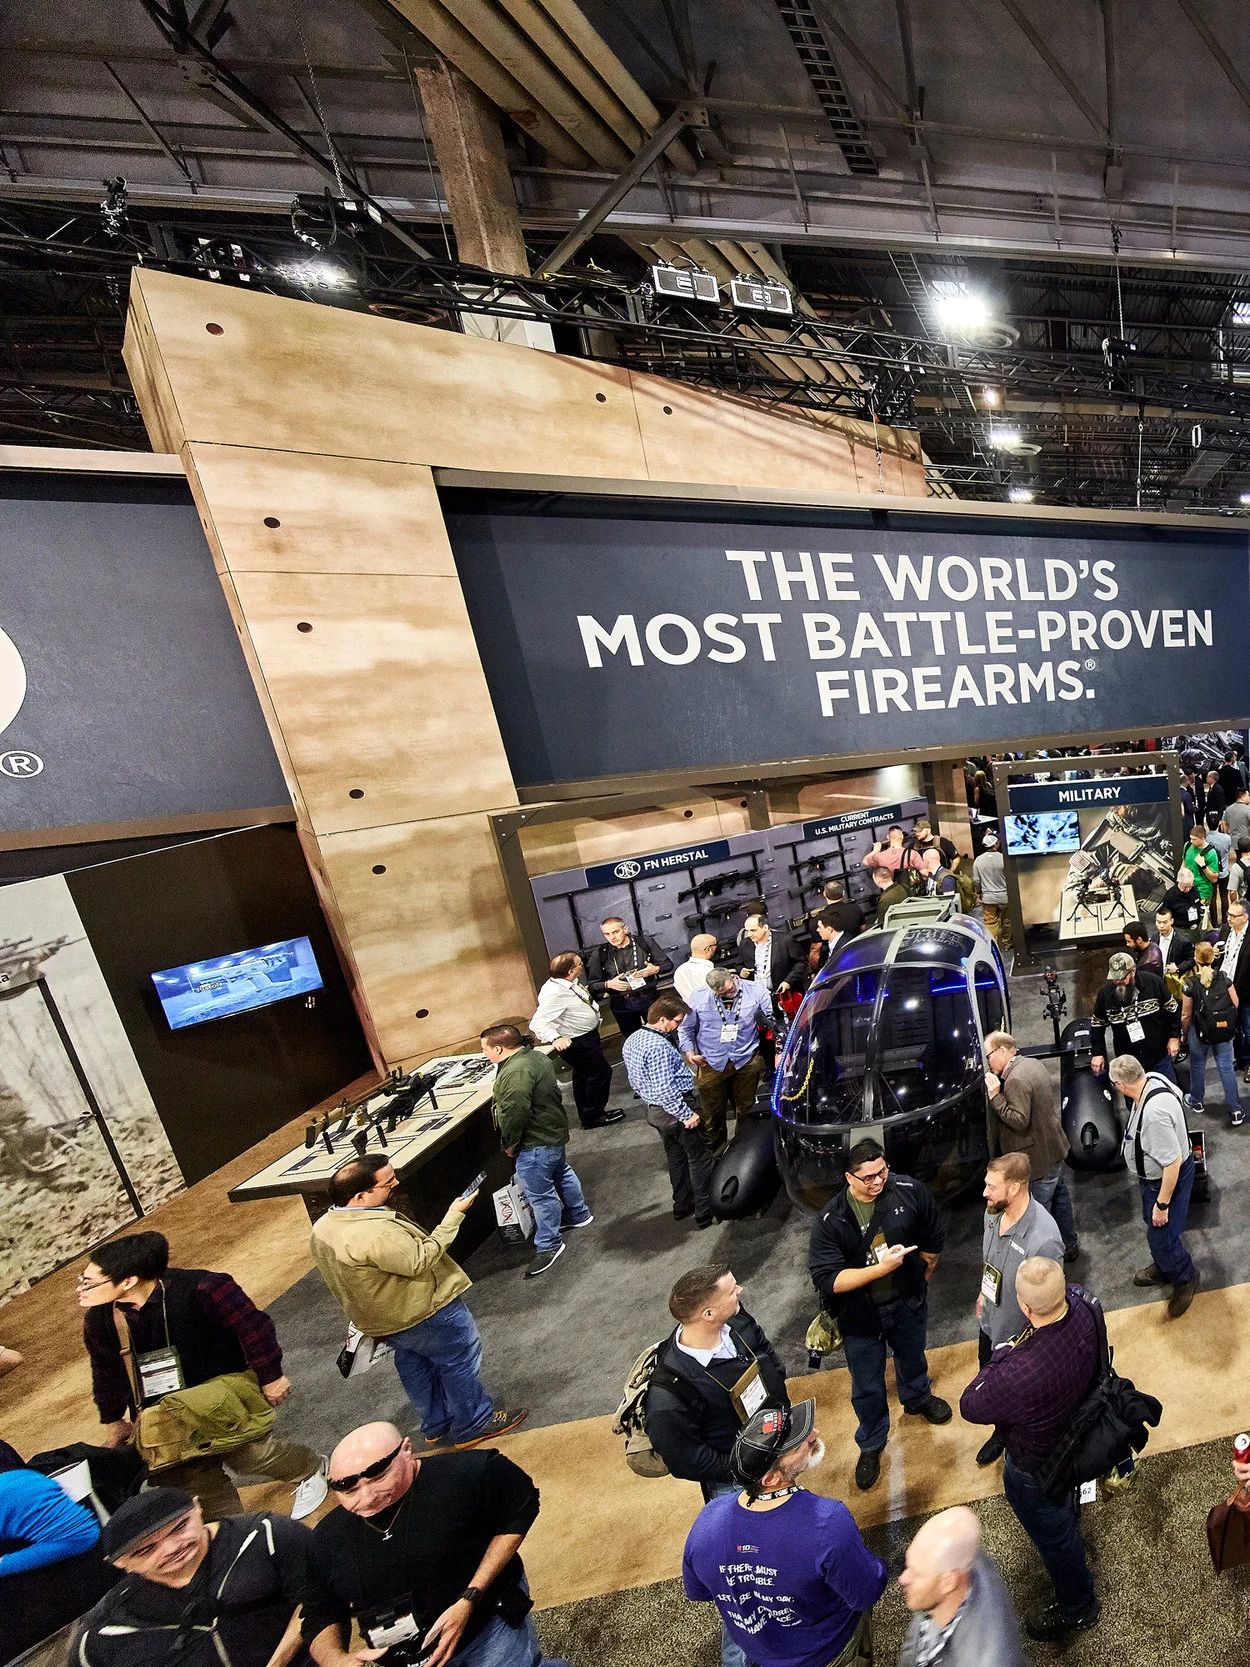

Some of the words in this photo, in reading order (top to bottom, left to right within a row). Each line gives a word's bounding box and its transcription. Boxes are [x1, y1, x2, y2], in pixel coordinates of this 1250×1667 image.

[724, 549, 861, 601] THE
[576, 612, 783, 668] MOST
[801, 609, 1214, 660] BATTLE-PROVEN
[1058, 786, 1122, 803] MILITARY
[828, 820, 858, 833] MILITARY
[858, 812, 895, 826] CONTRACTS
[840, 811, 870, 823] CURRENT
[643, 859, 660, 871] FN
[661, 849, 709, 867] HERSTAL
[719, 1565, 726, 1573] IF
[755, 1565, 778, 1577] MUST
[739, 1592, 752, 1605] BE
[747, 1614, 768, 1635] HAVE
